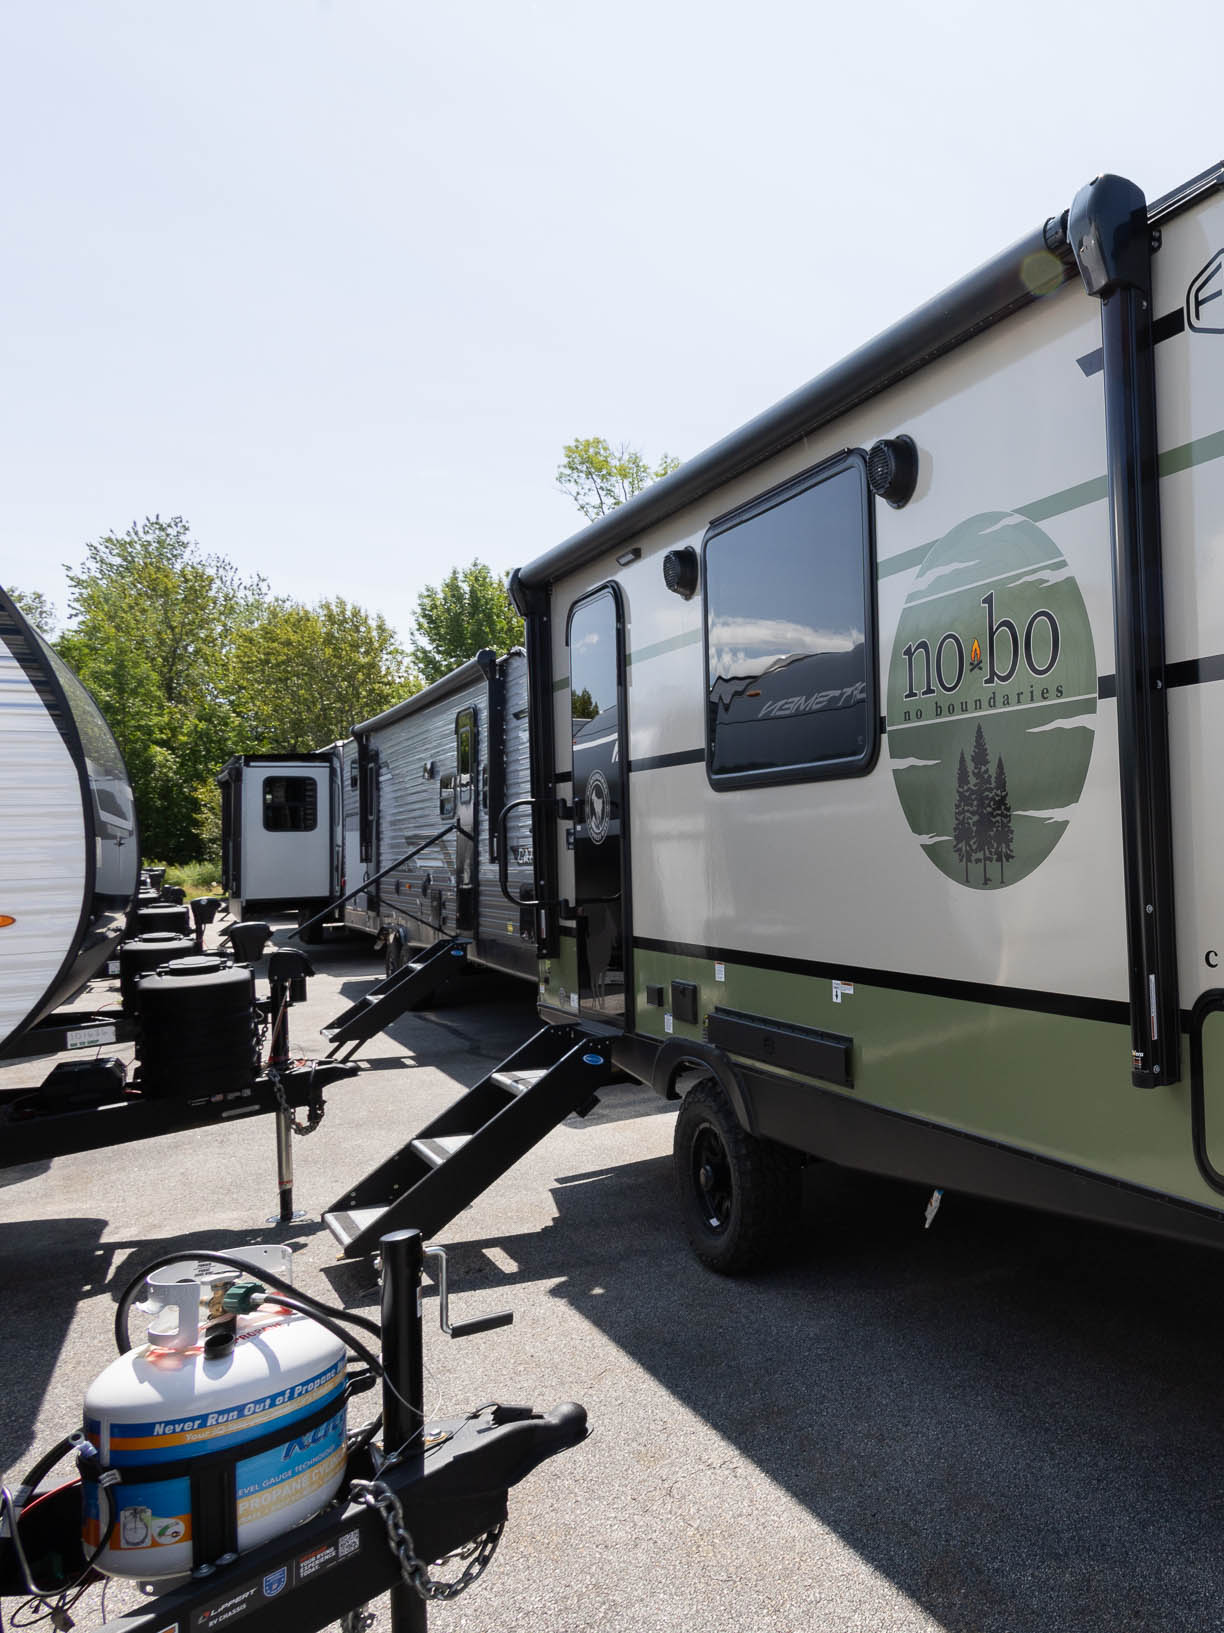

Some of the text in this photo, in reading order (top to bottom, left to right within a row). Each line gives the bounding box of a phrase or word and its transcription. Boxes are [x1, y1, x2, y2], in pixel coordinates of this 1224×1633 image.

[903, 683, 1066, 722] no boundaries
[1203, 949, 1219, 969] c
[153, 1419, 202, 1436] Never
[206, 1409, 238, 1425] Run
[243, 1398, 272, 1416] Out
[275, 1389, 291, 1406] of
[293, 1370, 336, 1395] Propane
[238, 1481, 260, 1497] EVEL
[262, 1469, 293, 1488] GAUGE
[238, 1476, 309, 1514] PROPANE
[210, 1586, 258, 1617] LIPPERT
[218, 1603, 247, 1622] CHASSIS
